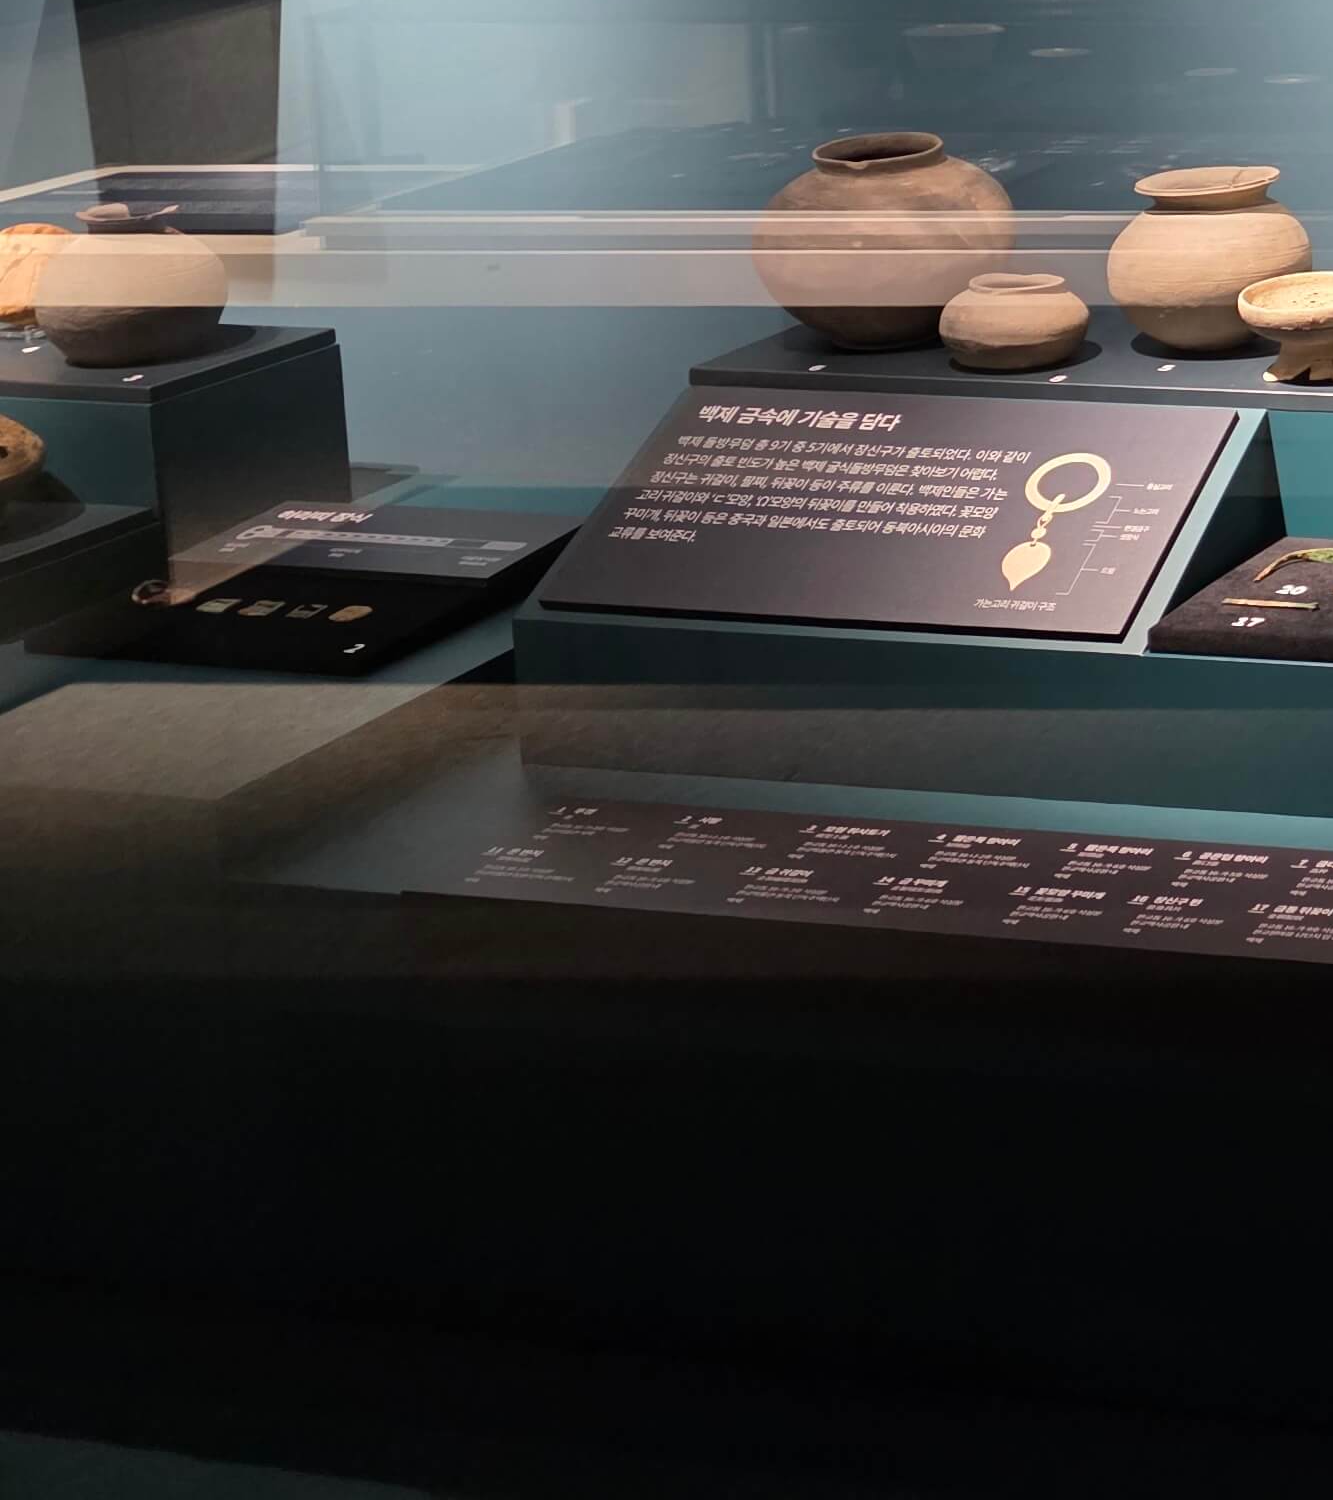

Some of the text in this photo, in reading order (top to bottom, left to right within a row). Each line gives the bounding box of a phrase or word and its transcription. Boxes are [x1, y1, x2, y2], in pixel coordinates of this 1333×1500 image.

[700, 406, 901, 431] 백제 금속에 기술을 담다
[1276, 585, 1307, 595] 20
[1232, 617, 1265, 627] 17
